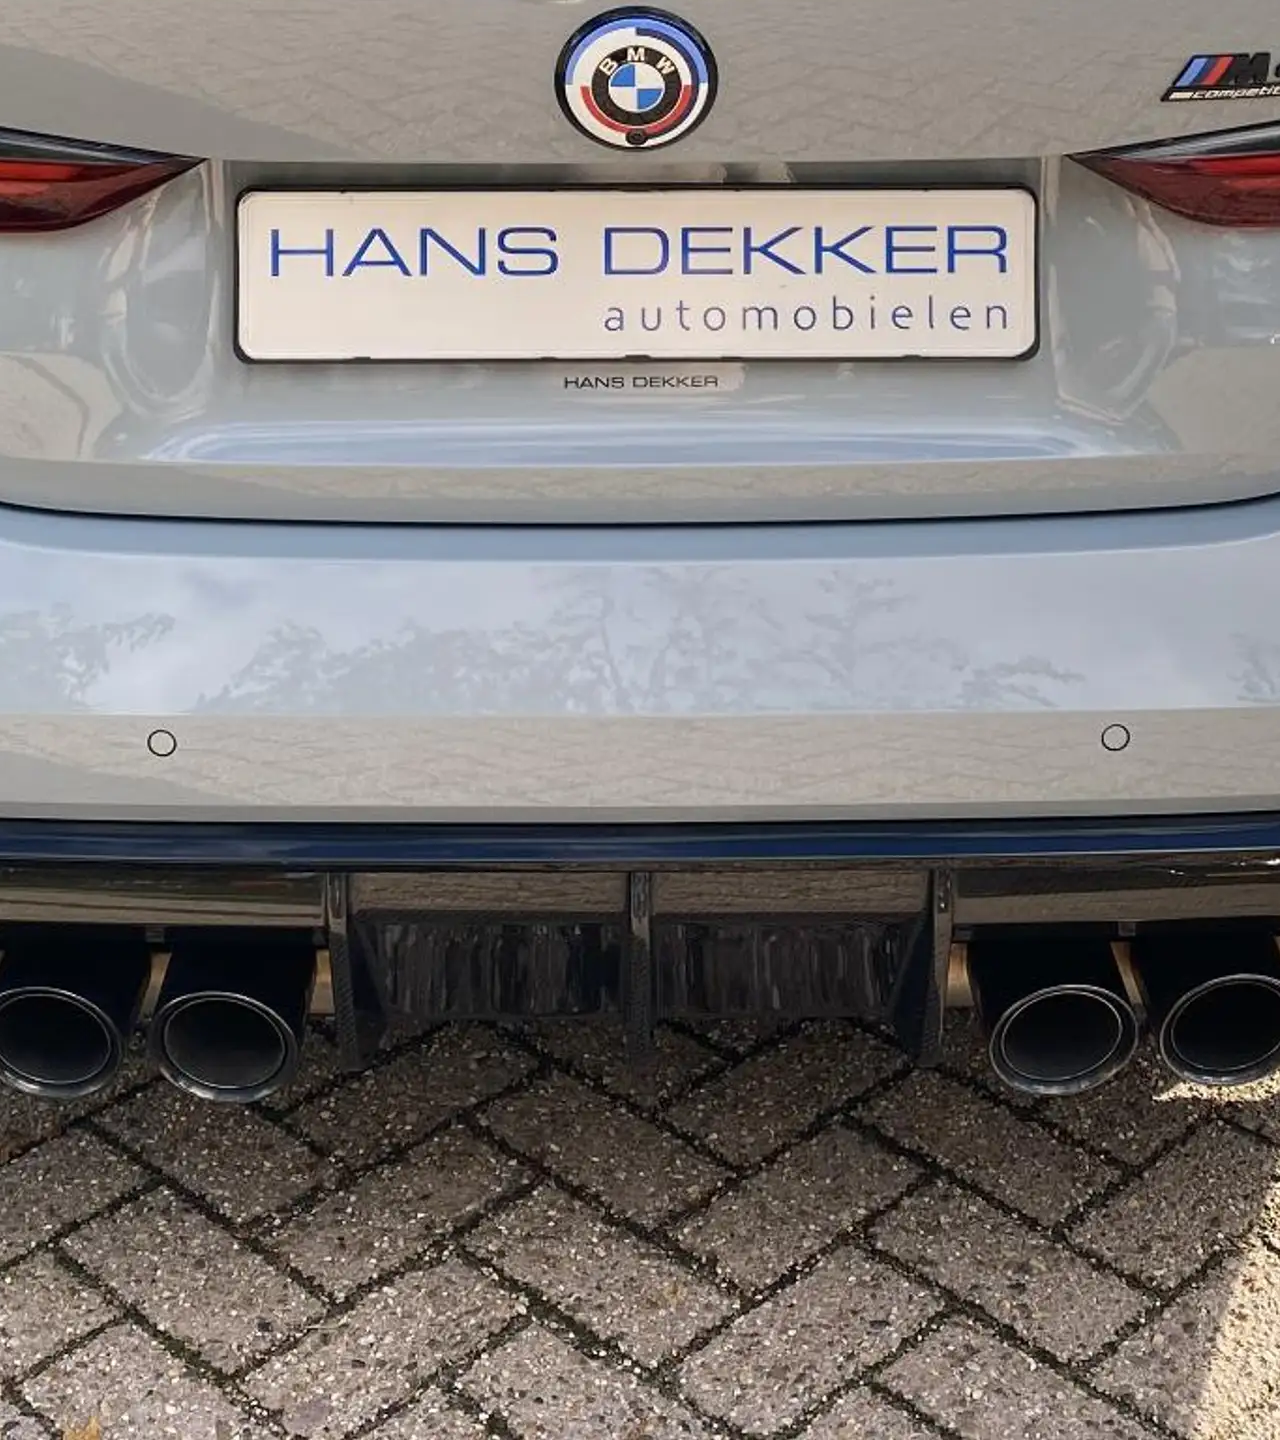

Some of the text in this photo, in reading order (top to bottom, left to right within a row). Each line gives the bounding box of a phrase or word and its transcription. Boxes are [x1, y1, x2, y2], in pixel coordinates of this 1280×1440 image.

[598, 46, 676, 76] BMW
[270, 224, 1008, 277] HANS DEKKER
[603, 293, 1008, 332] automobielen
[564, 375, 719, 389] HANS DEKKER
